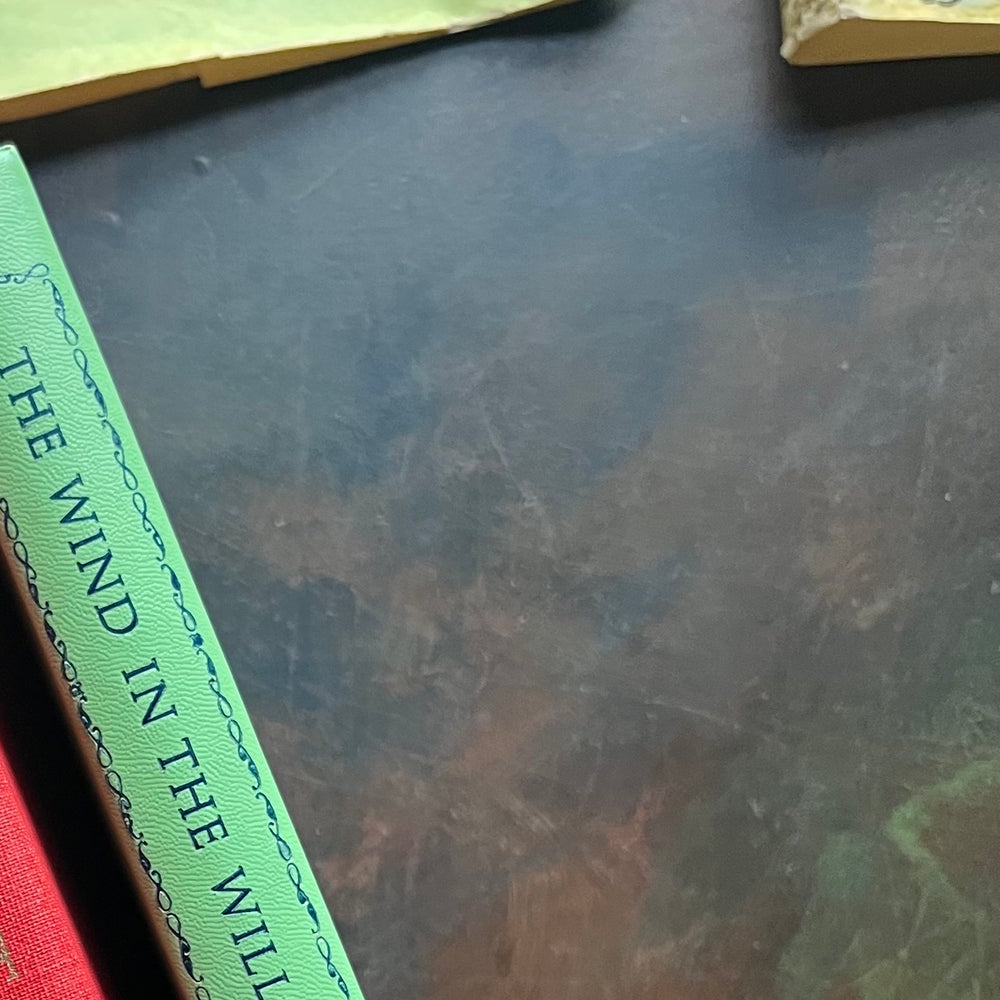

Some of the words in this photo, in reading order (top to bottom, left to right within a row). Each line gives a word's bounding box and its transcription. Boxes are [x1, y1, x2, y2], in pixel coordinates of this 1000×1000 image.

[49, 472, 141, 635] WIND
[121, 657, 179, 727] IN
[157, 737, 229, 850] THE
